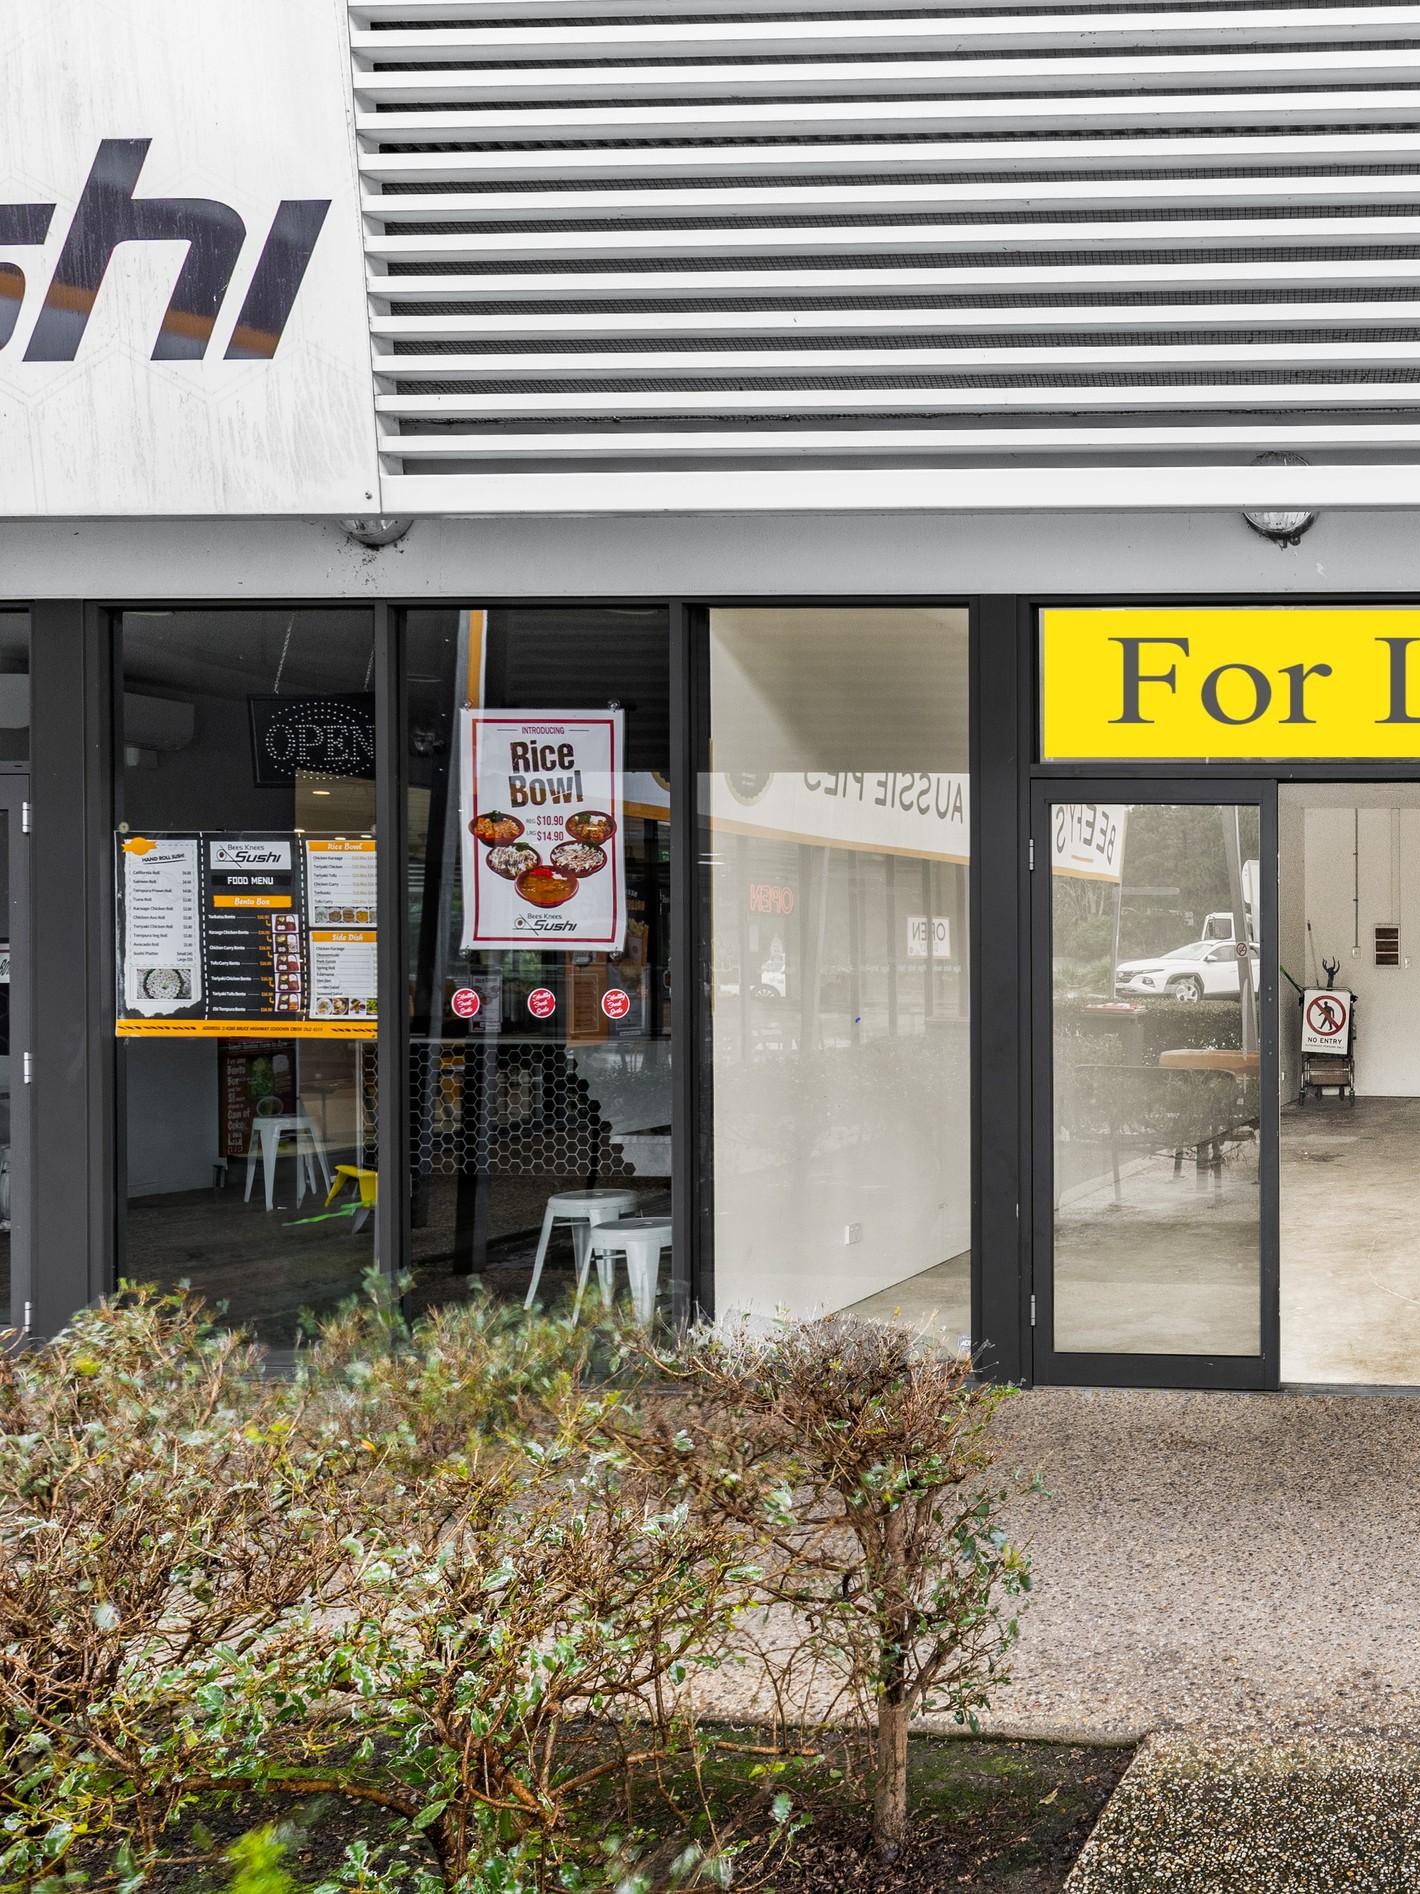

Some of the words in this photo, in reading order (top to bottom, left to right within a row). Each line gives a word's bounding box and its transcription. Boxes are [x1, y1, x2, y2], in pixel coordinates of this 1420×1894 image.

[1107, 636, 1333, 725] For
[521, 726, 565, 735] INTRODUCING
[264, 723, 375, 760] OPEN
[510, 740, 575, 774] Rice
[508, 770, 584, 808] Bowl
[536, 815, 564, 827] $10.90
[536, 831, 564, 842] $14.90
[235, 851, 282, 863] Sushi
[227, 876, 248, 885] FOOD
[251, 876, 274, 885] MENU
[532, 919, 578, 932] Sushi
